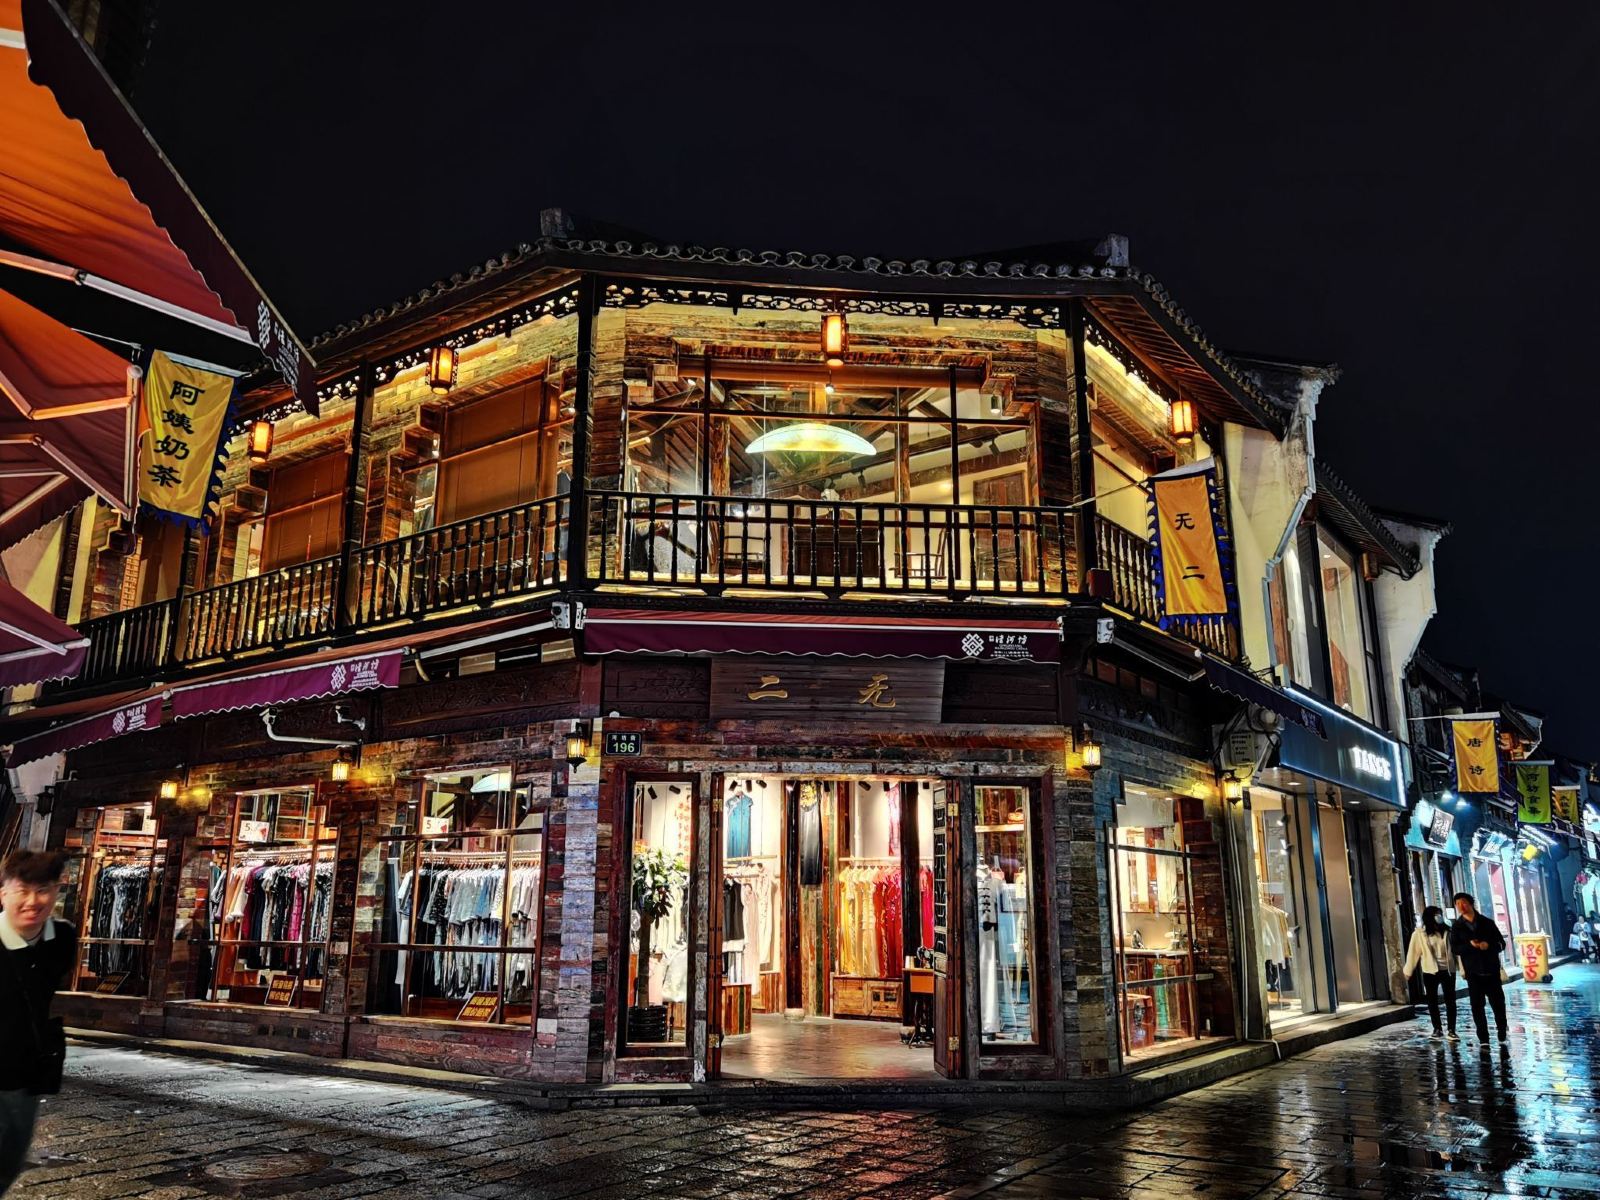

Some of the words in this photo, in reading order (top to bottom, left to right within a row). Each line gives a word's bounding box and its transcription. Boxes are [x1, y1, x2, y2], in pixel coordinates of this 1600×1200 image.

[147, 380, 206, 488] 阿姨奶茶
[1175, 512, 1205, 580] 无二
[613, 742, 635, 753] 196
[1467, 738, 1485, 775] 唐诗
[1521, 943, 1542, 956] 186
